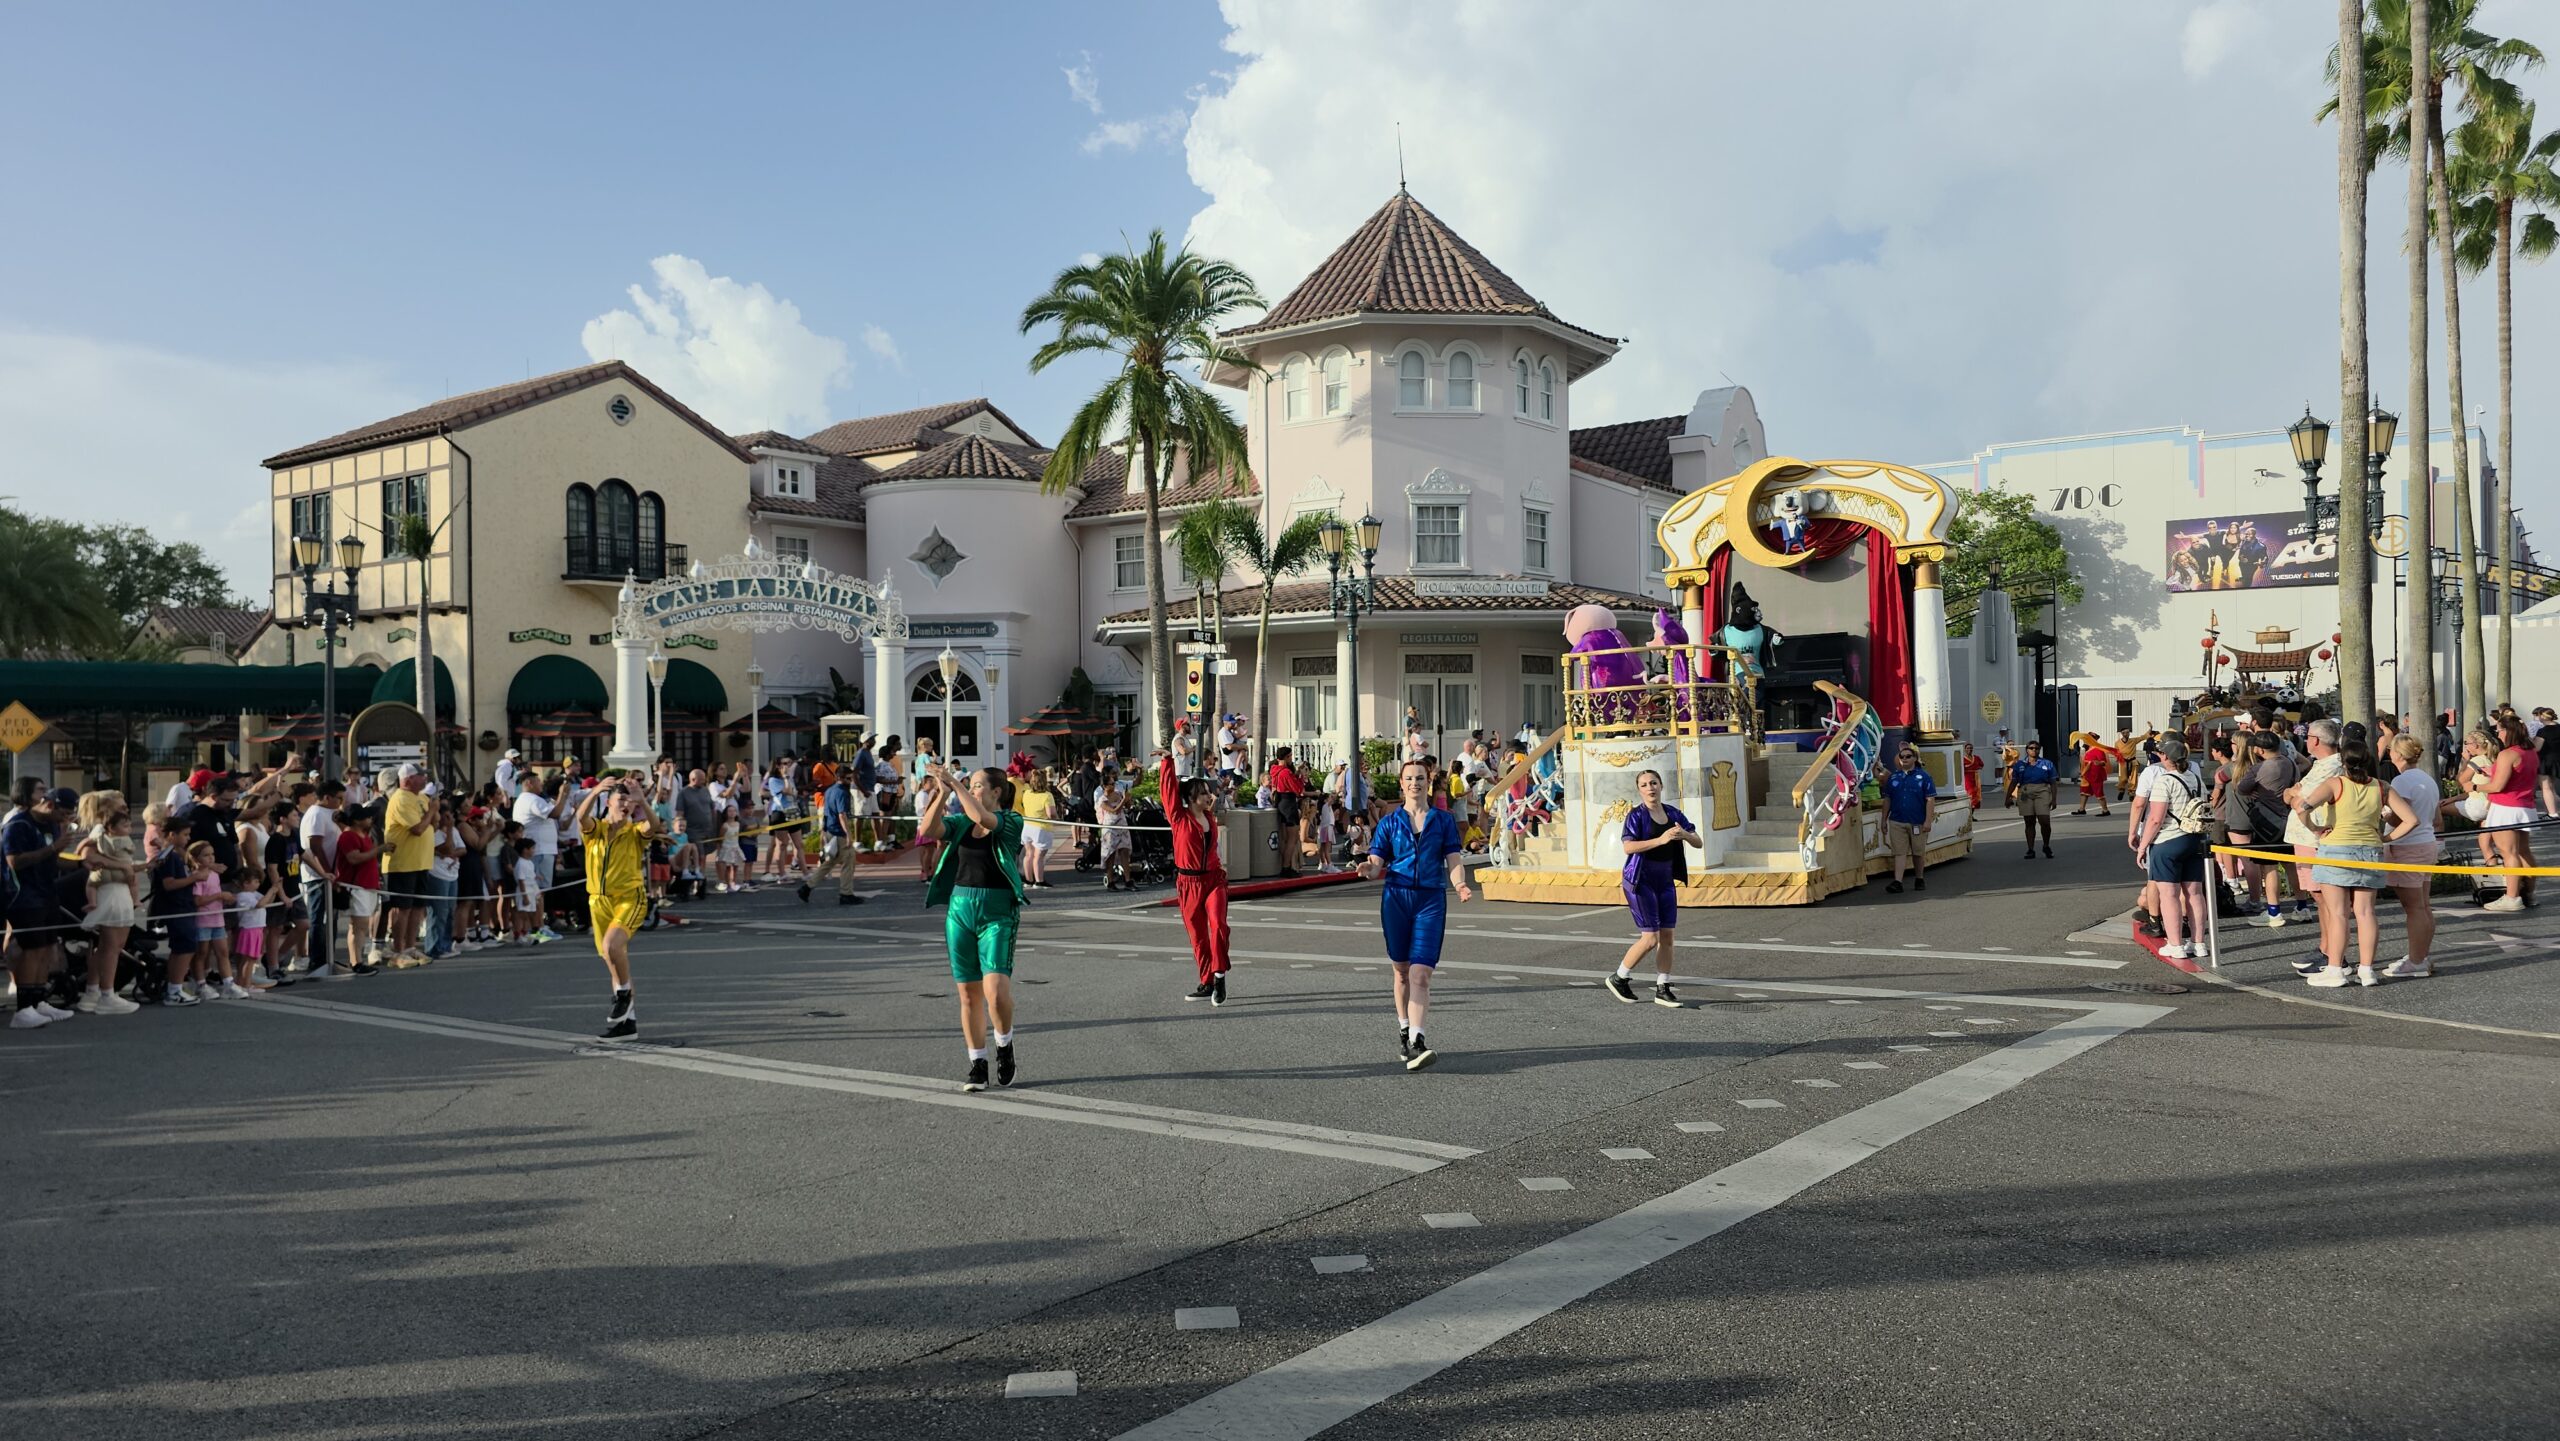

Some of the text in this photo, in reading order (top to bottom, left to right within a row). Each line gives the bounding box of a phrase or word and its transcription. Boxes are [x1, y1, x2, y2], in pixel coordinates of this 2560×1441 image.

[2271, 573, 2302, 581] TUESDAY
[1419, 582, 1545, 594] HOLLYWOOD HOTEL
[732, 578, 766, 599] LA
[774, 578, 868, 616] BAMBA
[741, 602, 789, 612] ORIGINAL
[794, 604, 852, 624] RESTAURANT
[913, 626, 941, 636] Bamba
[943, 625, 987, 635] Restaurant
[513, 628, 570, 645] COCKTAILS
[1402, 634, 1477, 643] REGISTRATION
[1178, 643, 1211, 654] HOLLYWOOD
[1225, 661, 1236, 673] GO
[5, 718, 30, 727] PED
[1, 727, 34, 737] XING
[835, 743, 858, 762] VIP
